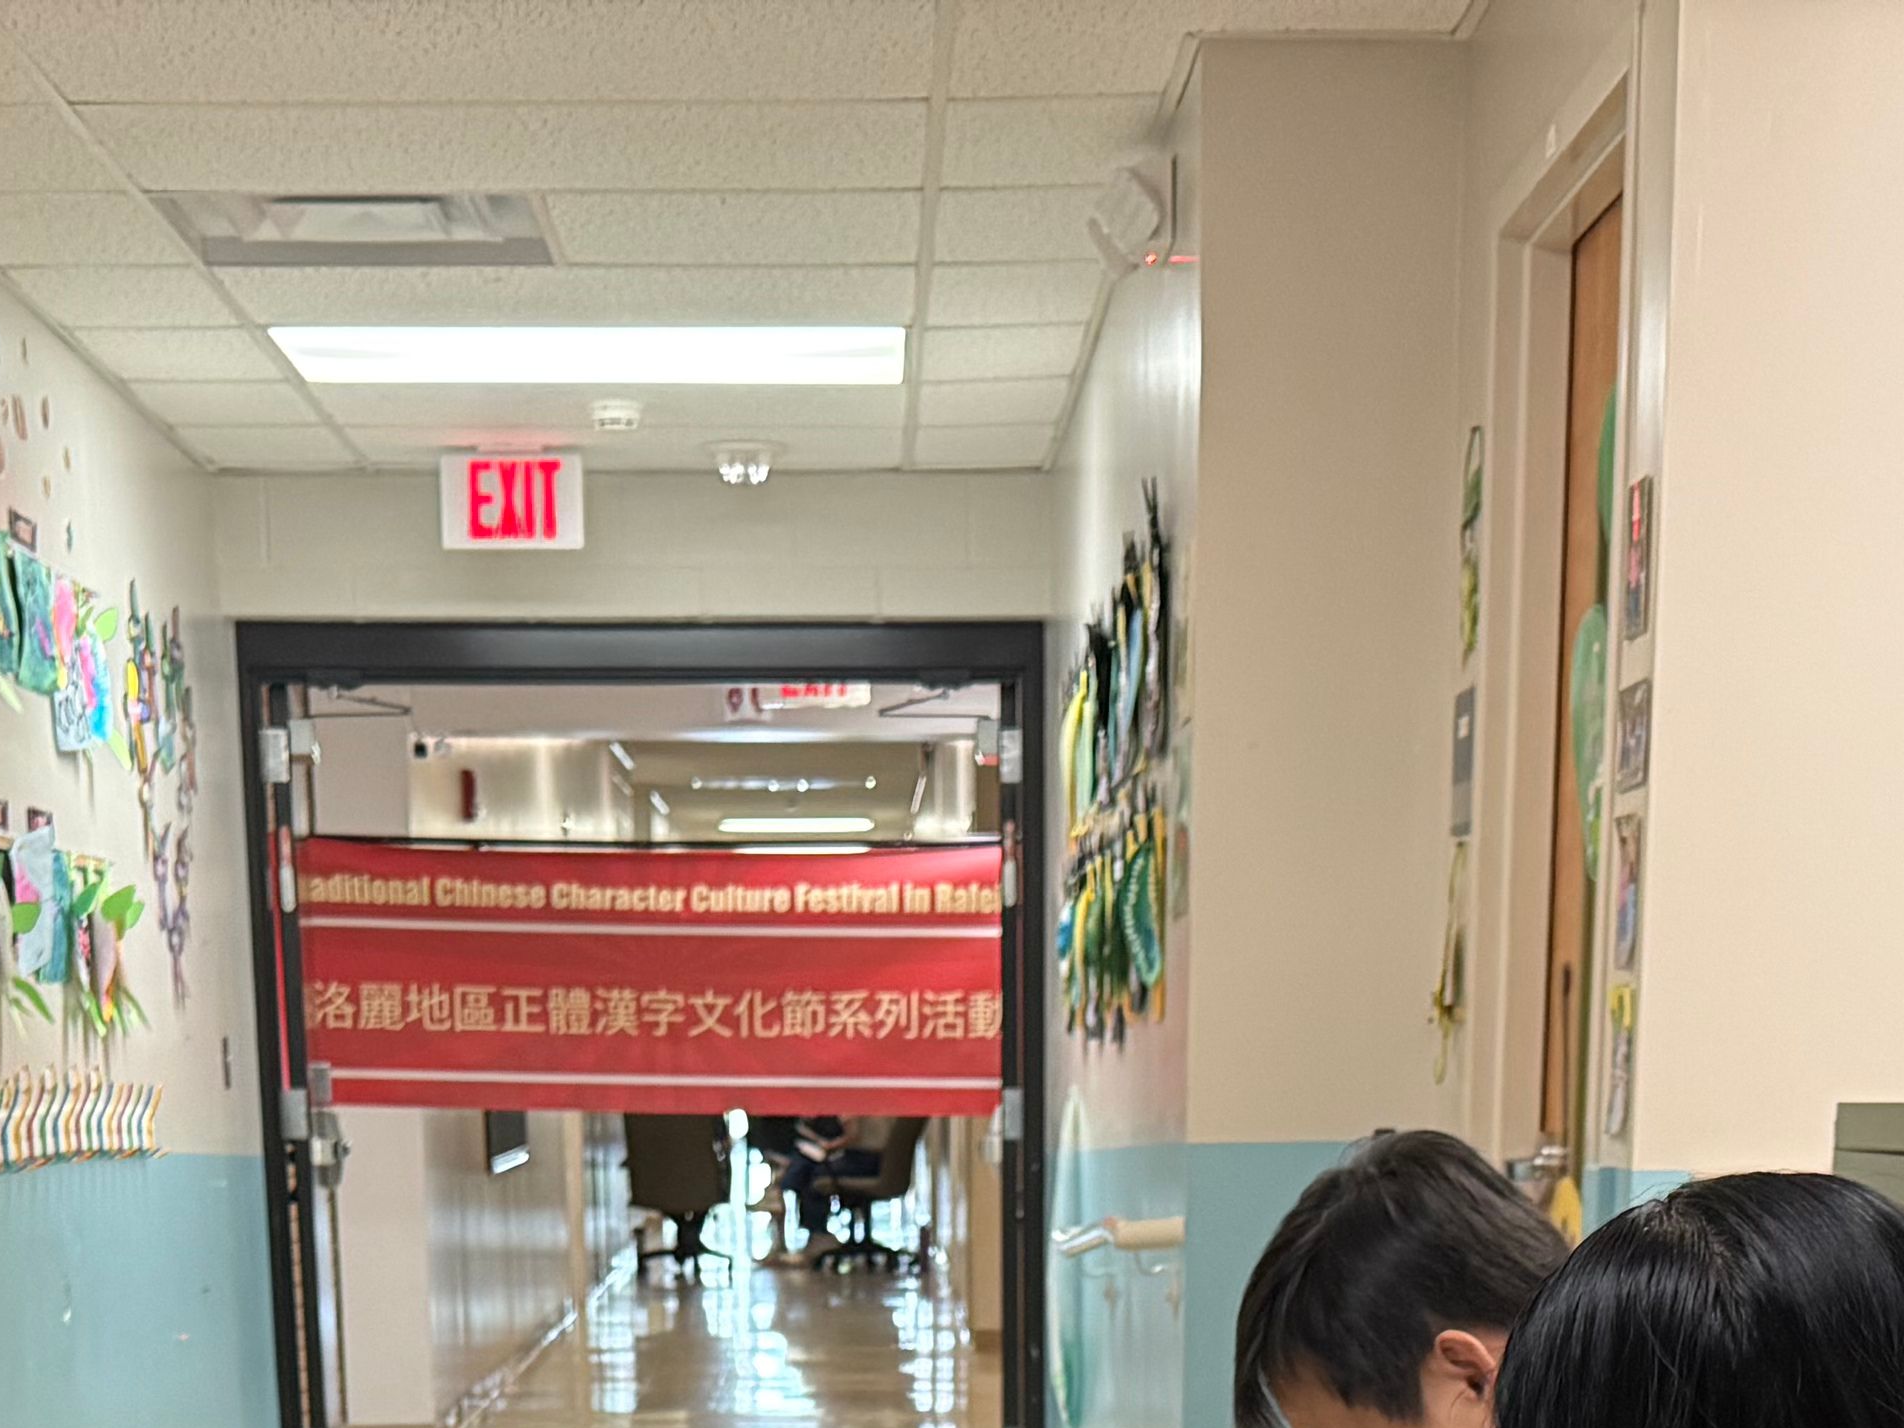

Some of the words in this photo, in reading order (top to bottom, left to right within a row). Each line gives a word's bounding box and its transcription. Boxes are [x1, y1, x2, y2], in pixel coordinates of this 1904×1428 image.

[467, 458, 563, 540] EXIT
[299, 873, 431, 905] aditional
[434, 877, 546, 908] Chinese
[550, 881, 688, 912] Character
[691, 881, 792, 913] Culture
[795, 880, 900, 914] Festival
[304, 980, 1003, 1040] 洛麗地區正體漢字文化節系列活動
